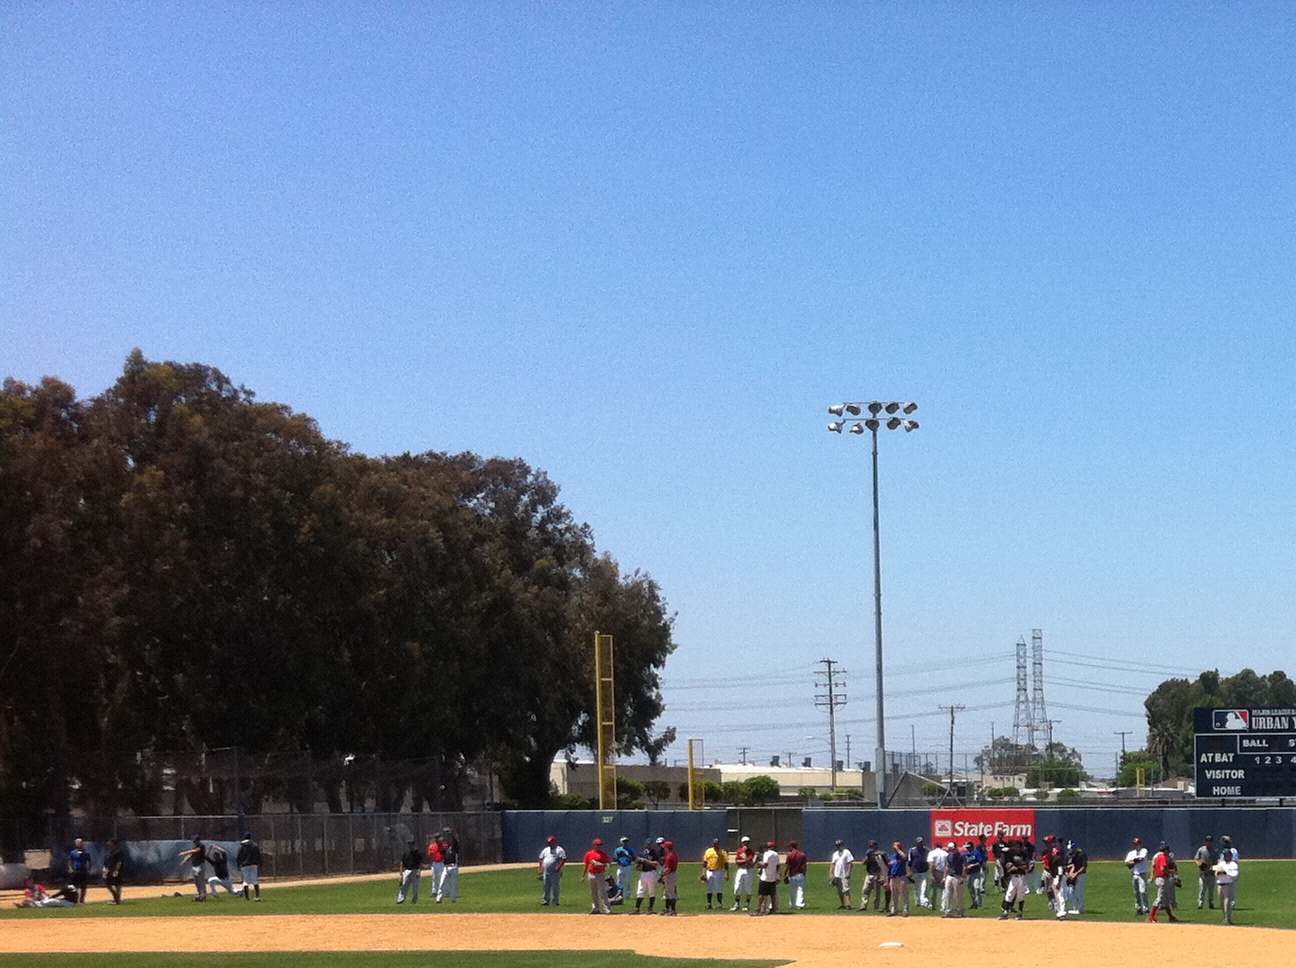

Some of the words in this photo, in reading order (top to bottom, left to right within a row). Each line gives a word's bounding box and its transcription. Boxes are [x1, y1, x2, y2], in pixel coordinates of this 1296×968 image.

[1252, 717, 1288, 730] URBAN
[1243, 739, 1268, 747] BALL
[1200, 754, 1214, 763] AT
[1215, 753, 1234, 762] BAT
[1255, 756, 1260, 764] 1
[1265, 756, 1271, 764] 2
[1276, 756, 1282, 764] 3
[1291, 756, 1296, 764] 4
[1206, 770, 1245, 779] VISITOR
[1213, 786, 1241, 795] HOME
